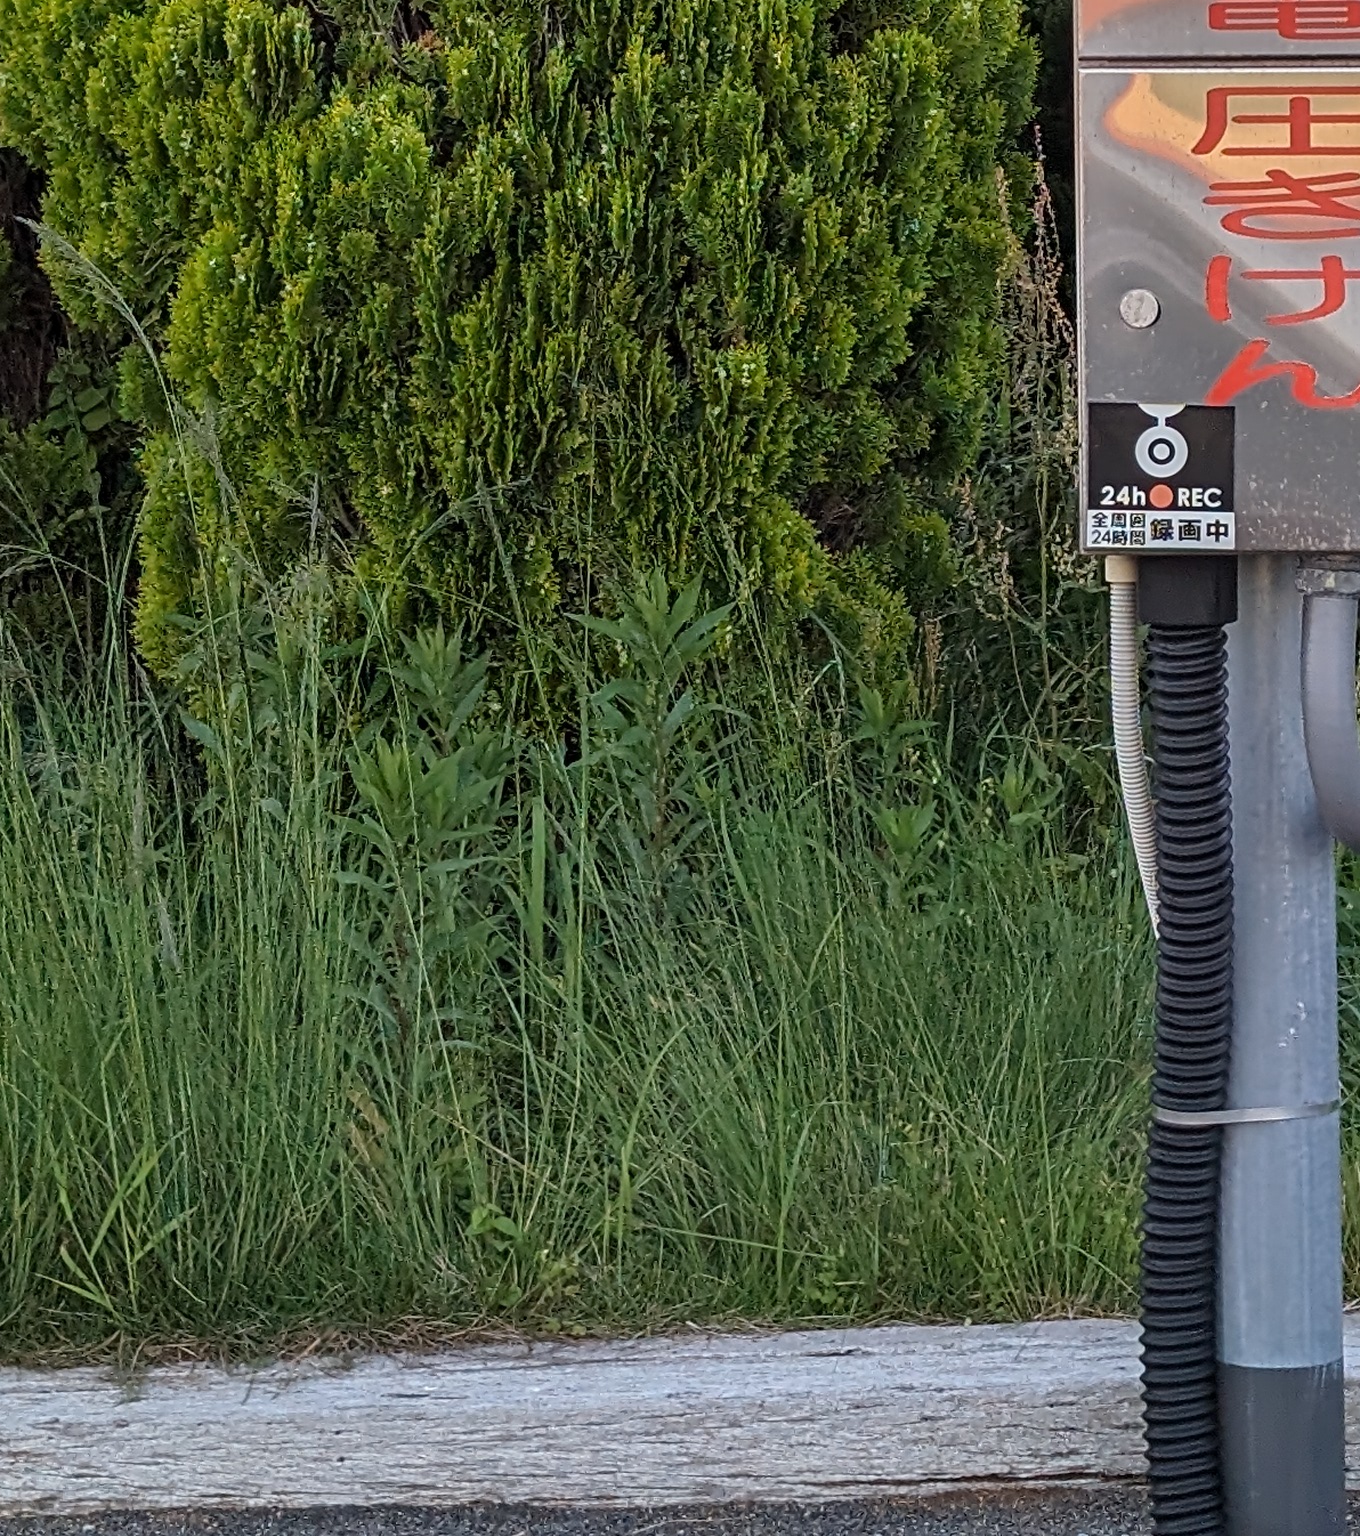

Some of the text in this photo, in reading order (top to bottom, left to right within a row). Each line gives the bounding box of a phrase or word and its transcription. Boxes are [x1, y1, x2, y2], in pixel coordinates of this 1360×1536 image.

[1100, 485, 1222, 507] 24h REC
[1091, 530, 1146, 545] 24時間
[1150, 518, 1230, 542] 録画中
